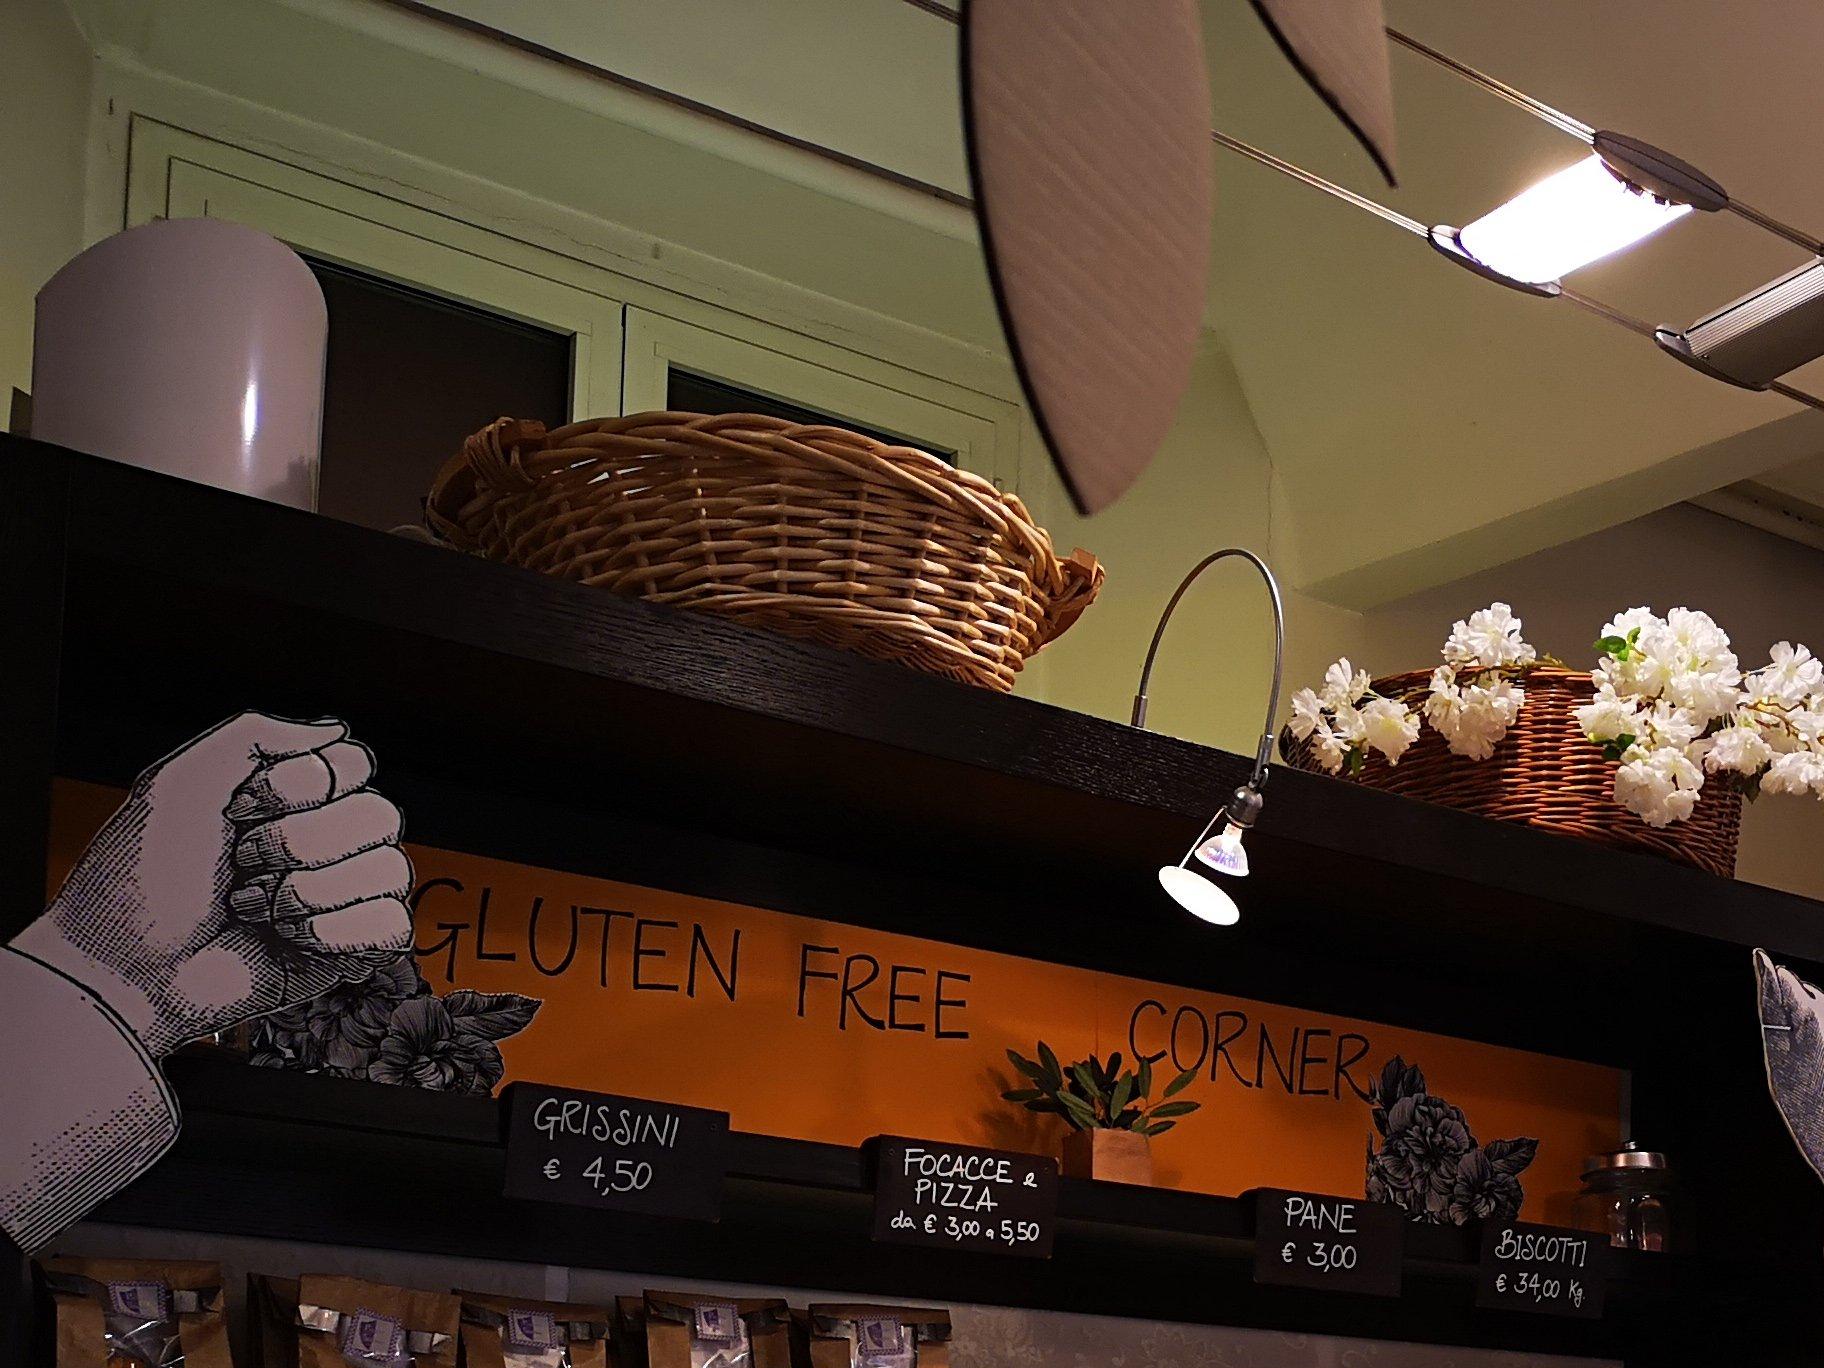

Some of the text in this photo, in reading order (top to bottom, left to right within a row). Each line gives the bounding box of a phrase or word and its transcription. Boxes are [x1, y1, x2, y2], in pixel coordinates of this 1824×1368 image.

[412, 877, 1376, 1103] GLUTEN FREE CORNER
[533, 1098, 680, 1148] GRISSINI
[543, 1158, 653, 1196] € 4,50
[904, 1148, 1013, 1185] FOCACCE
[914, 1178, 998, 1213] PIZZA
[890, 1213, 916, 1231] da
[923, 1216, 937, 1235] €
[944, 1216, 980, 1241] 3,00
[1000, 1220, 1040, 1246] 5,50
[1285, 1197, 1358, 1235] PANE
[1281, 1241, 1358, 1273] € 3,00
[1494, 1228, 1587, 1268] BISCOTTI
[1495, 1273, 1508, 1294] €
[1513, 1272, 1561, 1303] 34,00
